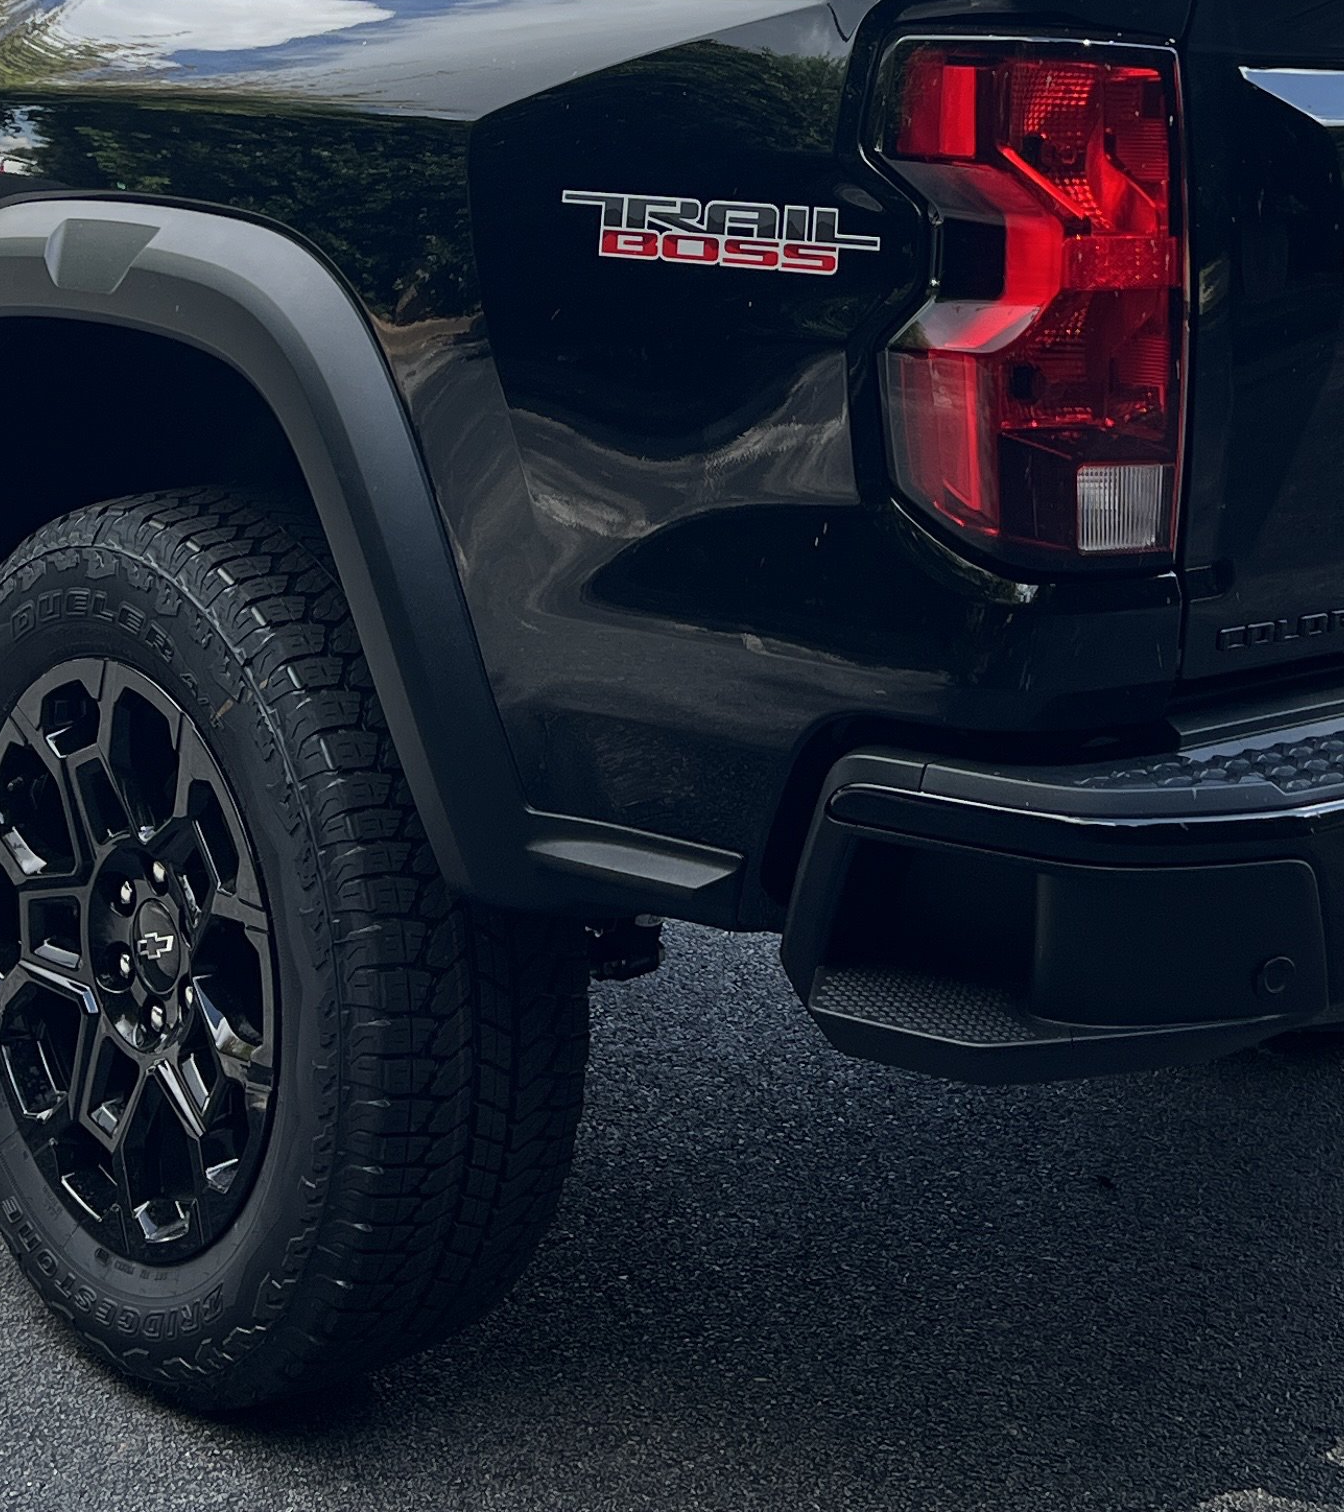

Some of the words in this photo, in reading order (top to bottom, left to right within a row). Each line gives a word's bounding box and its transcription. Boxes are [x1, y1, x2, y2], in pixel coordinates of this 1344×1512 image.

[562, 190, 881, 251] TRAIL
[599, 229, 839, 275] BOSS
[10, 586, 176, 665] DUELER
[1, 1196, 224, 1341] BRIDGESTONE
